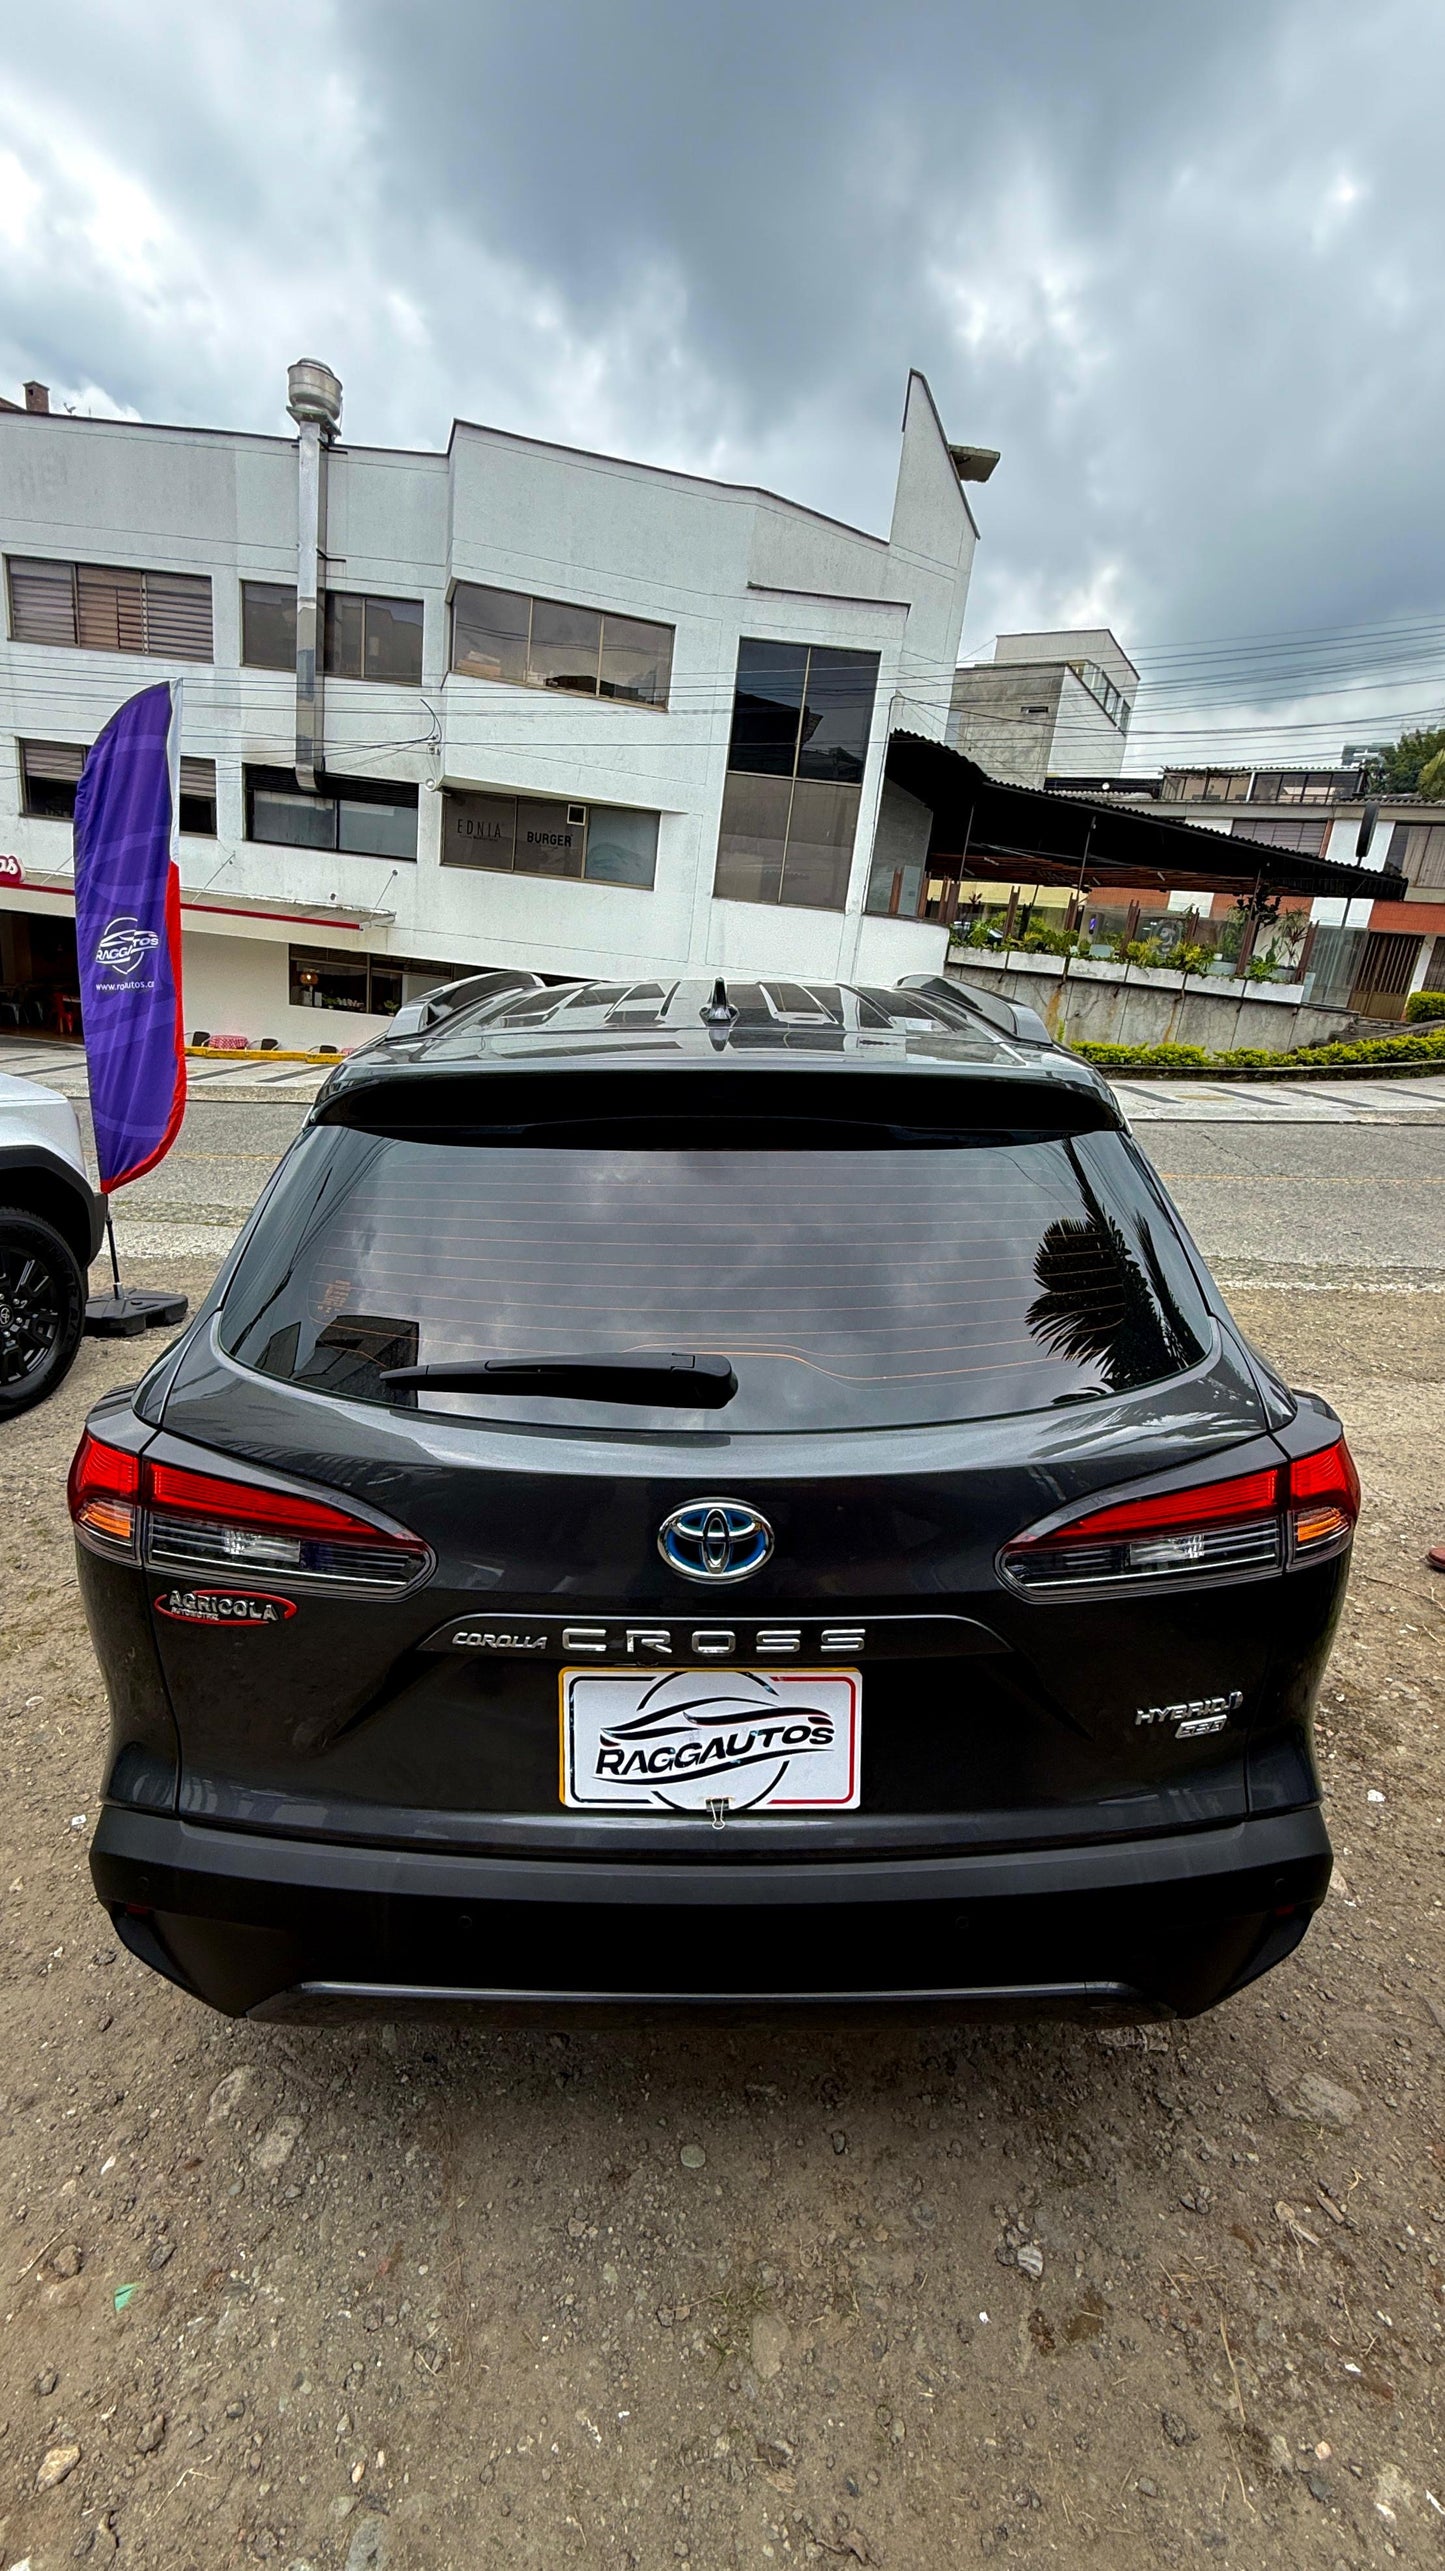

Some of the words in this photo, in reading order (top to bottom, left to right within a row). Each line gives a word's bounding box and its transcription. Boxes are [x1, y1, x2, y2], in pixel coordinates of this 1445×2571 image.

[527, 831, 572, 847] BURGER
[169, 1590, 279, 1621] AGRICOLA
[452, 1631, 549, 1649] COROLLA
[562, 1628, 866, 1653] CROSS
[1135, 1697, 1227, 1725] HYBRID
[595, 1724, 835, 1776] RAGGAUTOS
